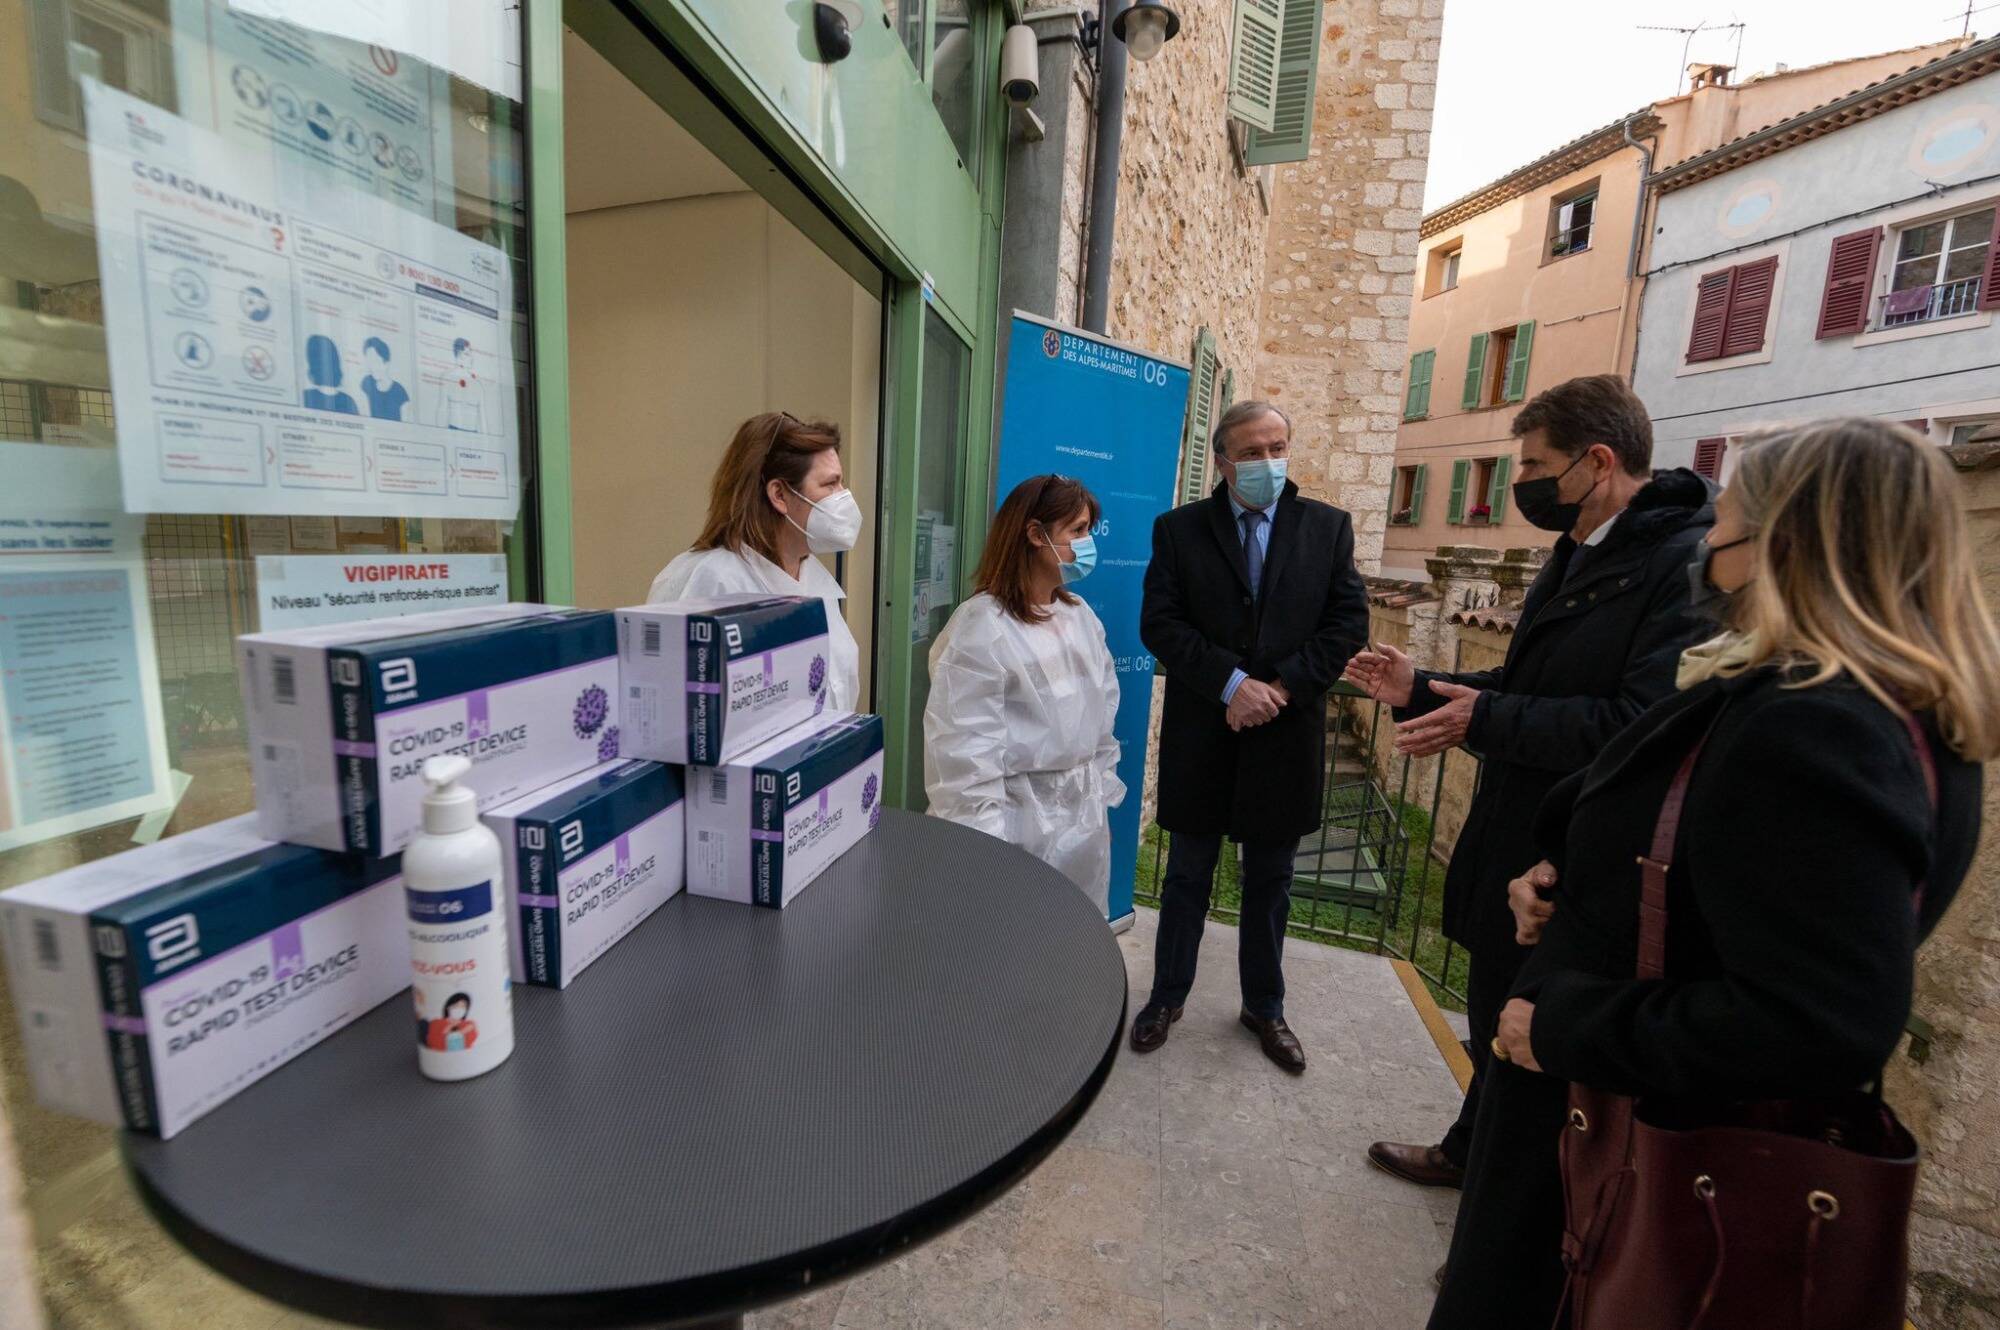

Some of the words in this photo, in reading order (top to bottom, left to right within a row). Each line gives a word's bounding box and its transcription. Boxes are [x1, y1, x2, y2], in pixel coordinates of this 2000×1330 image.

[1063, 336, 1139, 366] DEPARTEMENT
[1063, 349, 1077, 362] DES
[1078, 354, 1138, 379] ALPES-MARITIMES
[1144, 361, 1168, 387] 06
[1092, 519, 1110, 537] 06
[344, 563, 450, 583] VIGIPIRATE
[272, 595, 321, 611] Niveau
[324, 590, 377, 607] "sécurité
[378, 586, 462, 603] renforcée-risque
[463, 583, 500, 598] attentat"
[1135, 655, 1151, 672] 06
[731, 672, 763, 694] COVID-19
[731, 695, 752, 712] RAPID
[753, 687, 767, 706] TEST
[767, 680, 789, 698] DEVICE
[389, 721, 465, 756] COVID-19
[479, 725, 527, 752] DEVICE
[787, 837, 809, 857] RAPID
[808, 826, 823, 846] TEST
[823, 808, 843, 834] DEVICE
[788, 810, 819, 840] COVID-19
[567, 863, 614, 904] COVID-19
[567, 896, 601, 928] RAPID
[601, 878, 623, 905] TEST
[623, 855, 656, 883] DEVICE
[165, 965, 269, 1027] COVID-19
[167, 1008, 240, 1057] RAPID
[242, 981, 287, 1017] TEST
[291, 944, 359, 991] DEVICE
